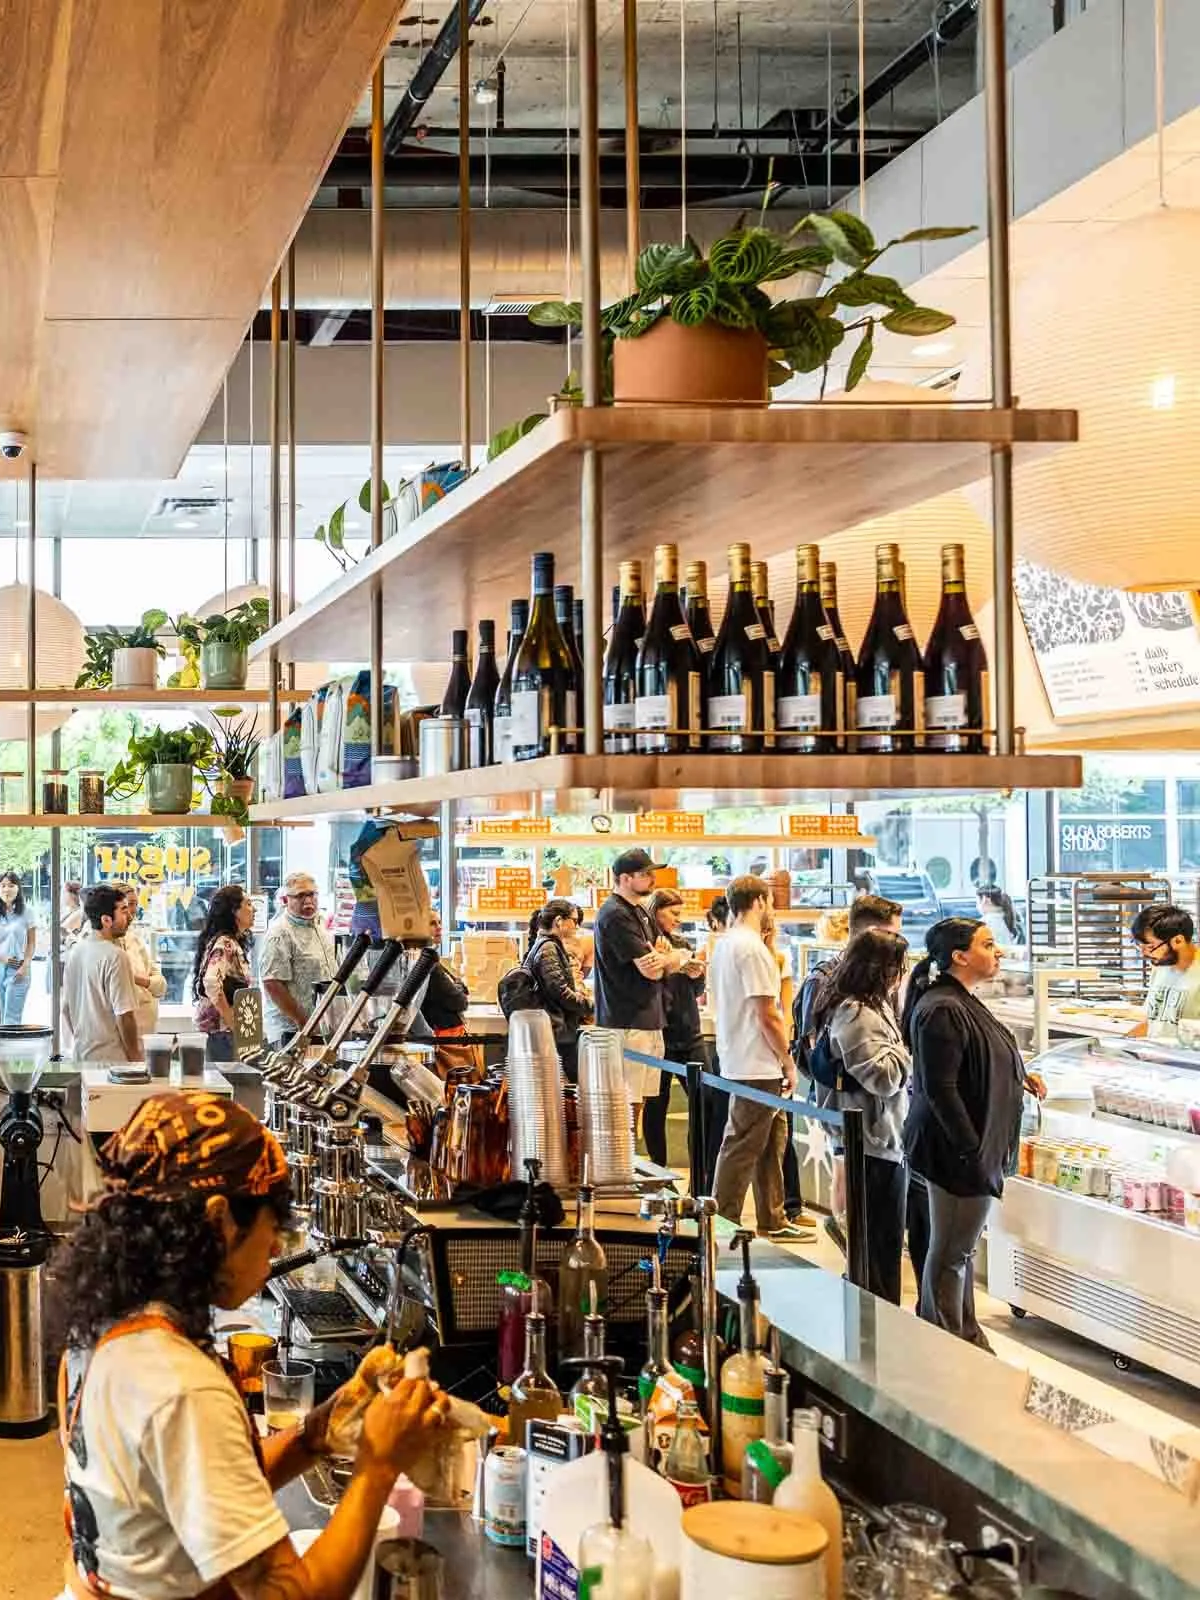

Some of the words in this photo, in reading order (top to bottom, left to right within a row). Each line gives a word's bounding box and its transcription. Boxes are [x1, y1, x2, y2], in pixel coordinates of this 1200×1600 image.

[1144, 645, 1169, 661] daily
[1147, 660, 1185, 677] bakery
[1154, 673, 1200, 691] schedule
[1062, 824, 1097, 839] OLGA
[1097, 824, 1152, 839] ROBERTS
[1062, 838, 1107, 851] STUDIO
